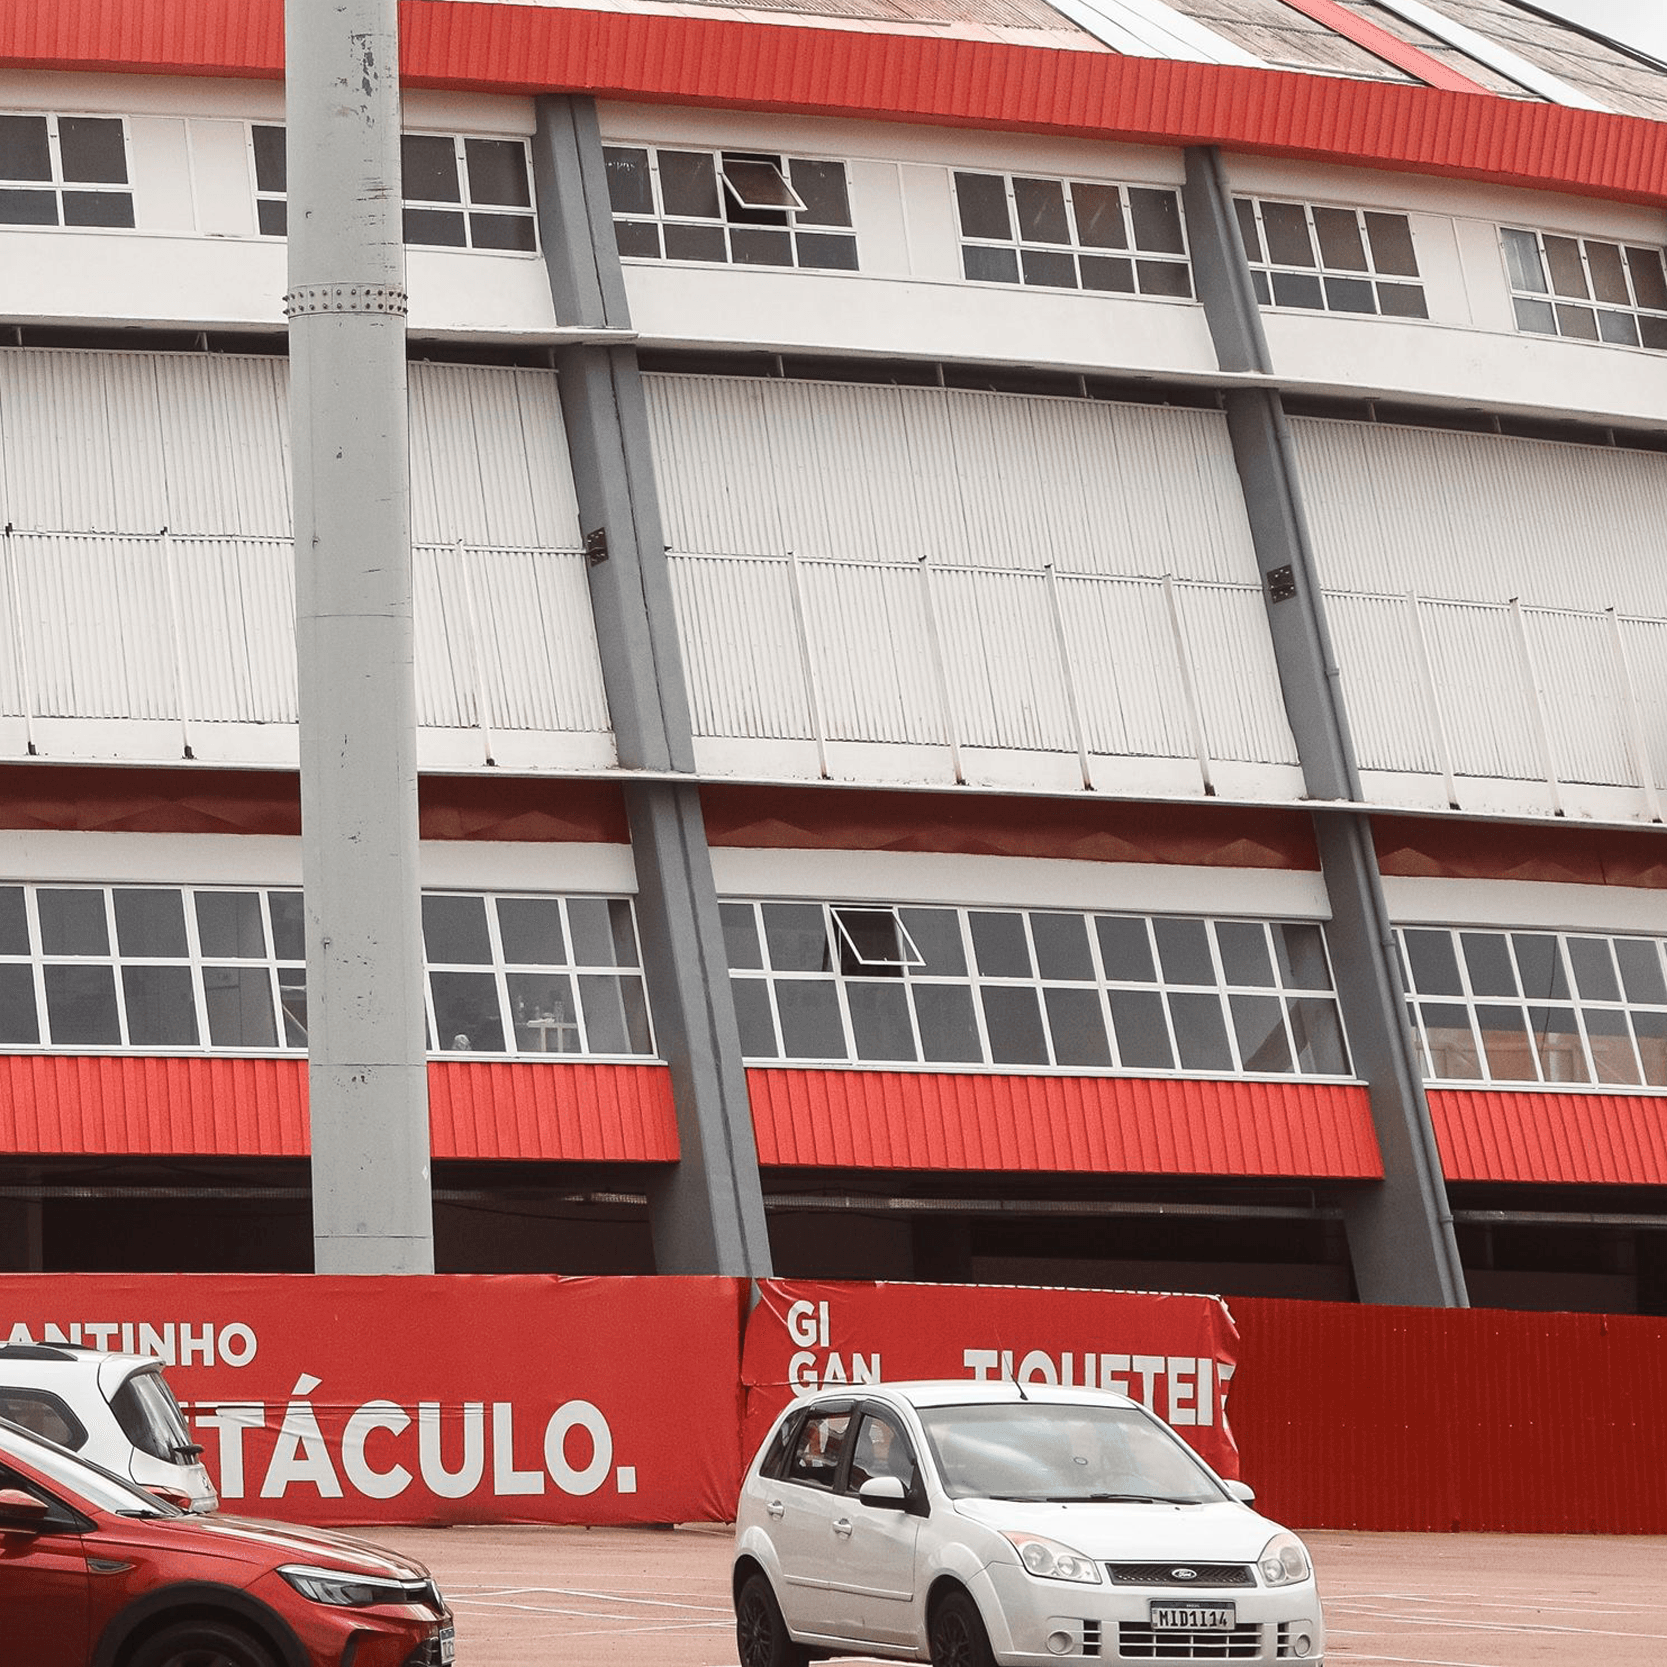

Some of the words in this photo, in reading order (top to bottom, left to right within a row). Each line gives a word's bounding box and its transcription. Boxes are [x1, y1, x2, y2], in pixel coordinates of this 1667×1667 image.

[787, 1299, 830, 1348] GI
[788, 1350, 881, 1398] GAN
[178, 1372, 637, 1499] TÁCULO.
